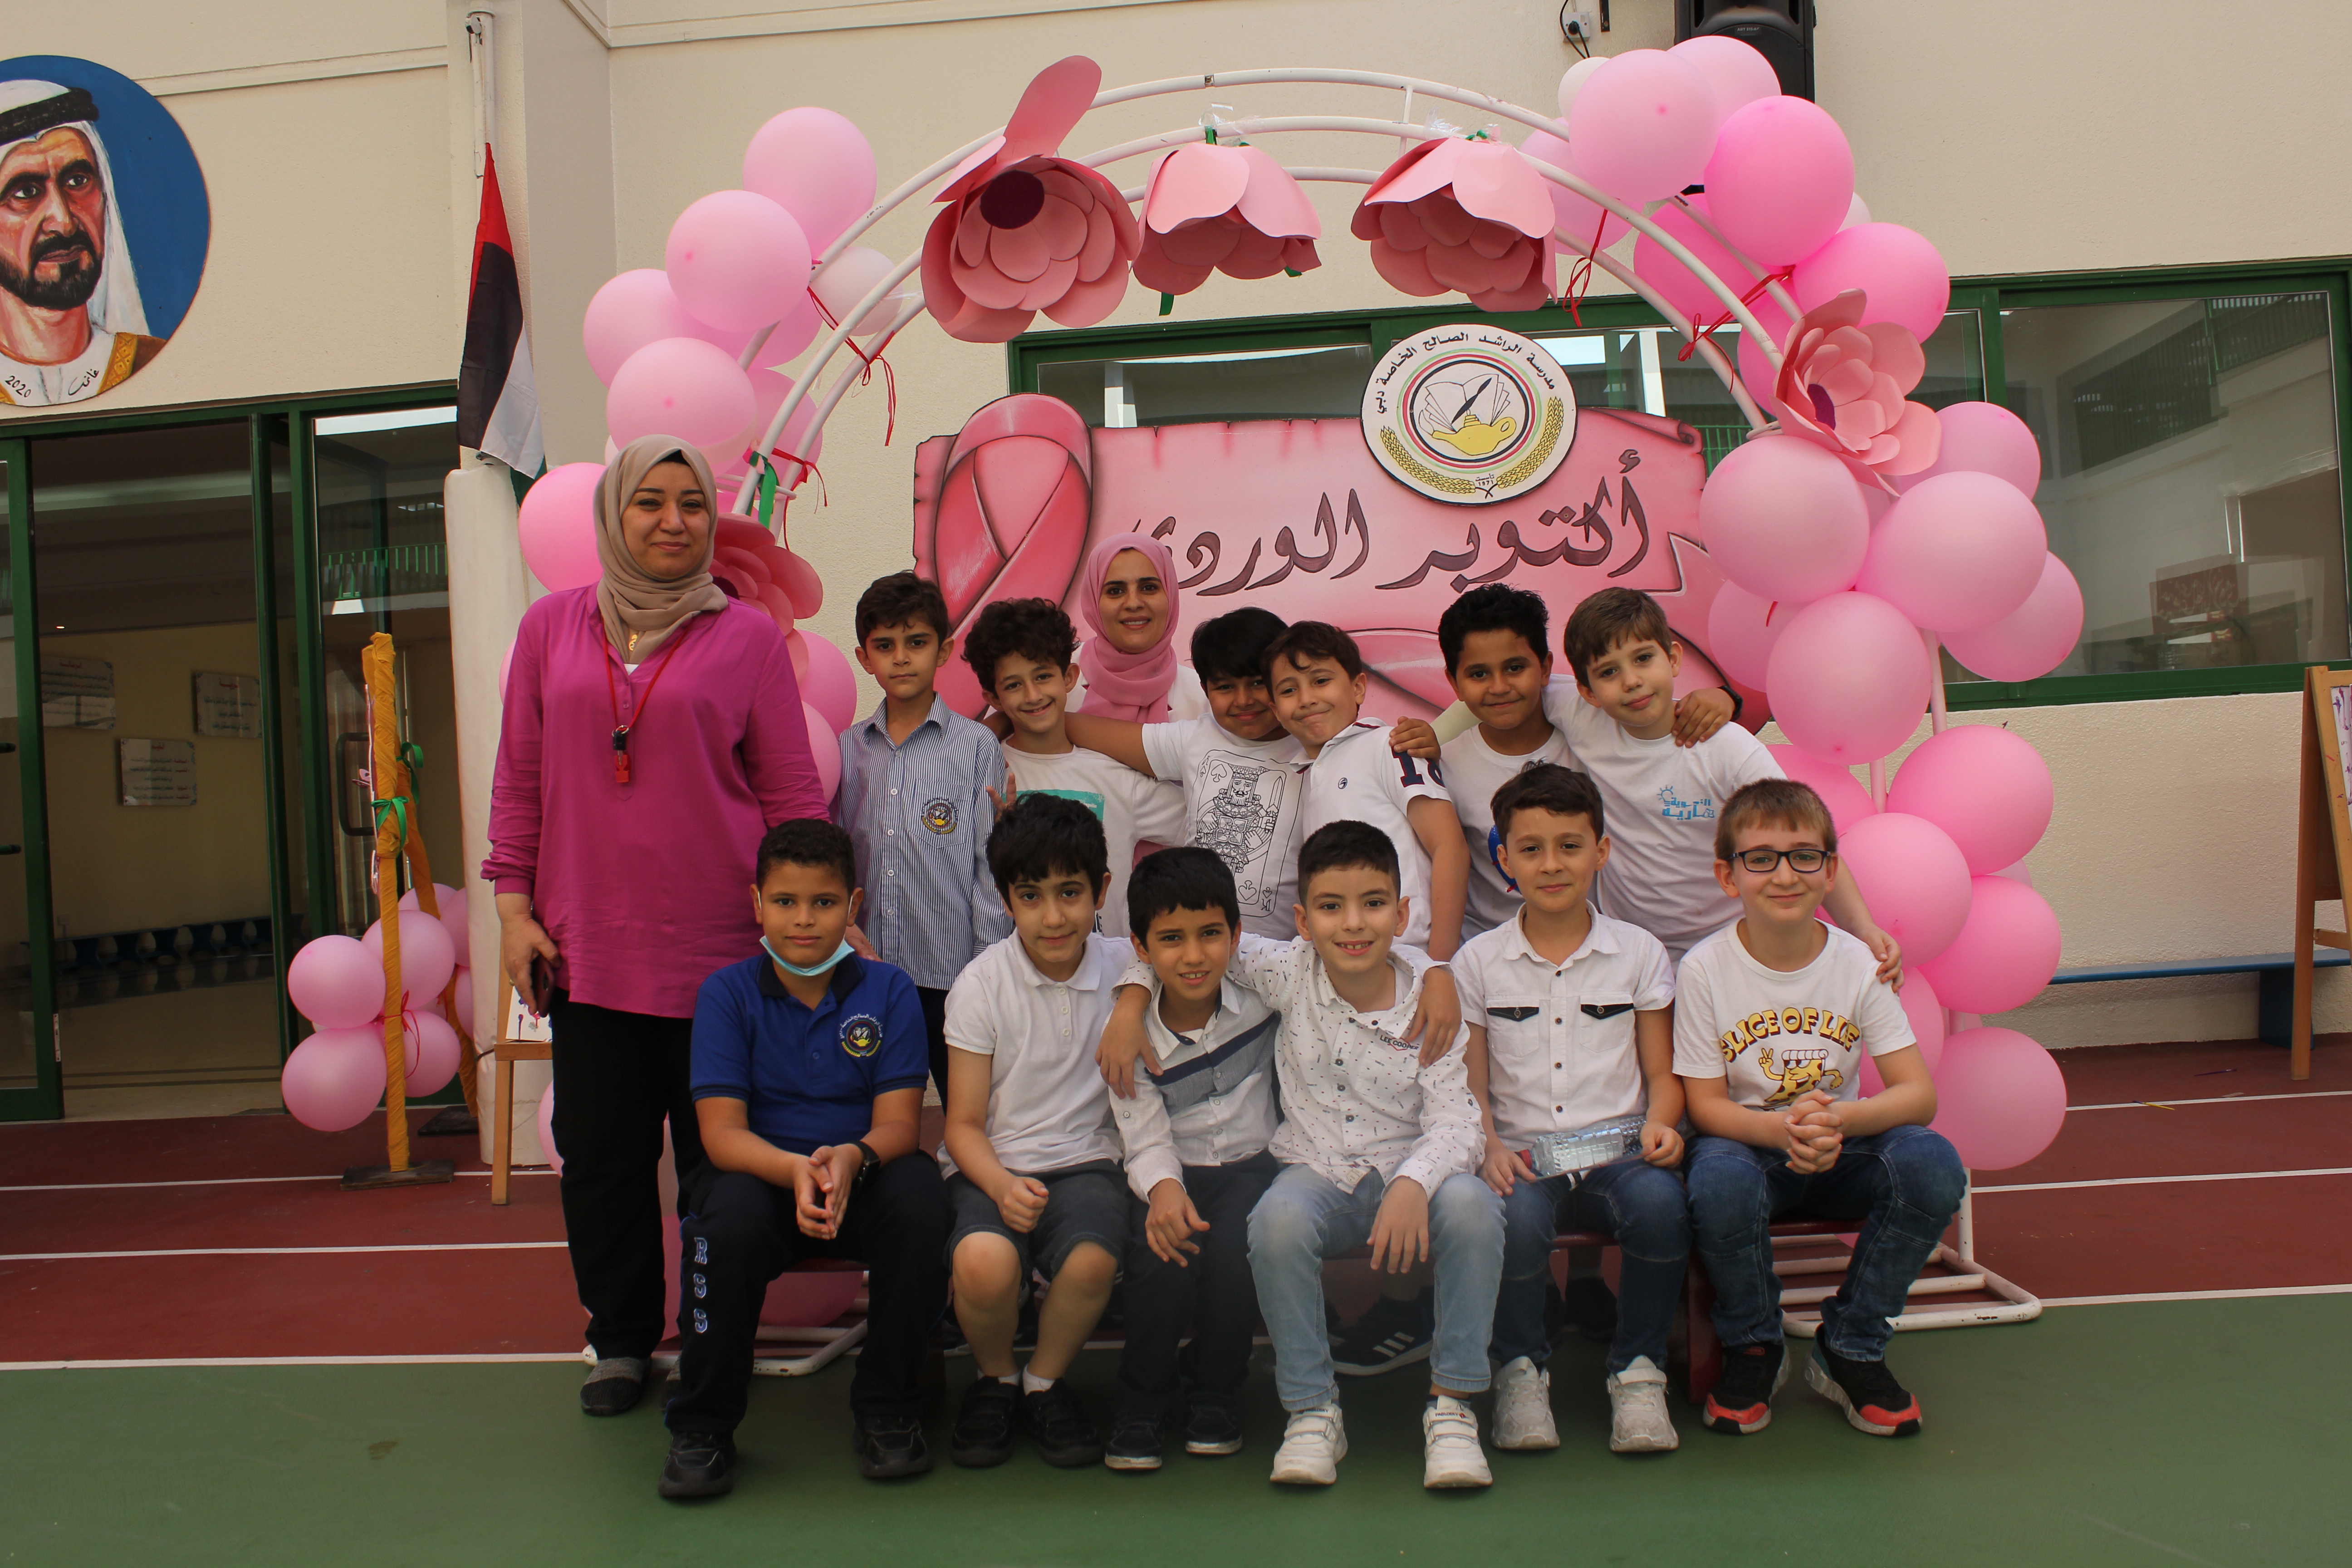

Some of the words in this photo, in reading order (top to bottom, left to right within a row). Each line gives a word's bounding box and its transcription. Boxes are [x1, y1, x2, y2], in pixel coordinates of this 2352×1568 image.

[1422, 332, 1469, 351] الصالح
[1479, 334, 1523, 354] الراشد
[1375, 346, 1417, 386] الخاصة
[1526, 352, 1555, 389] مدرسة
[5, 375, 32, 398] 2020
[1376, 391, 1387, 414] دبي
[1375, 449, 1649, 593] أكتوبر
[1132, 488, 1369, 596] الورد
[1781, 1007, 1819, 1035] OF
[1380, 1034, 1392, 1044] LEE
[1393, 1040, 1419, 1050] COOPER
